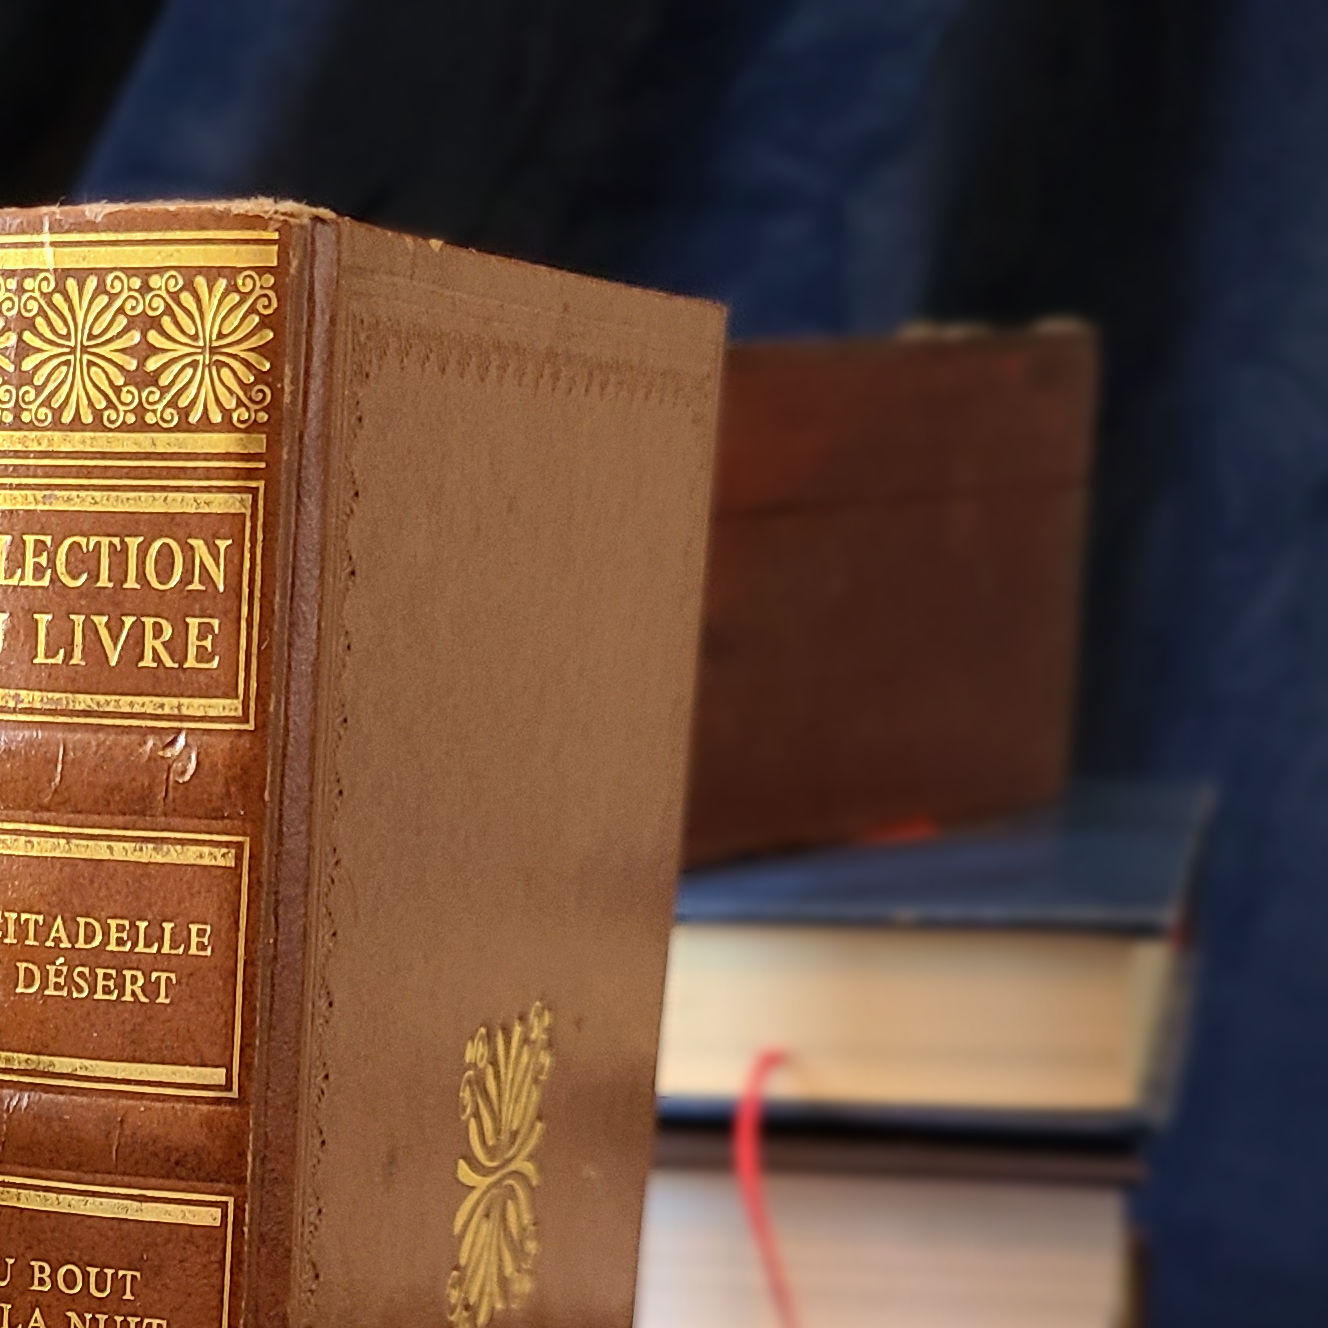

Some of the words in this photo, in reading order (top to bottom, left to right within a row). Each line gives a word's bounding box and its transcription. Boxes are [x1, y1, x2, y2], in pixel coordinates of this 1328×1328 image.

[32, 612, 221, 669] LIVRE
[16, 956, 177, 1005] DÉSERT
[30, 1260, 141, 1301] BOUT
